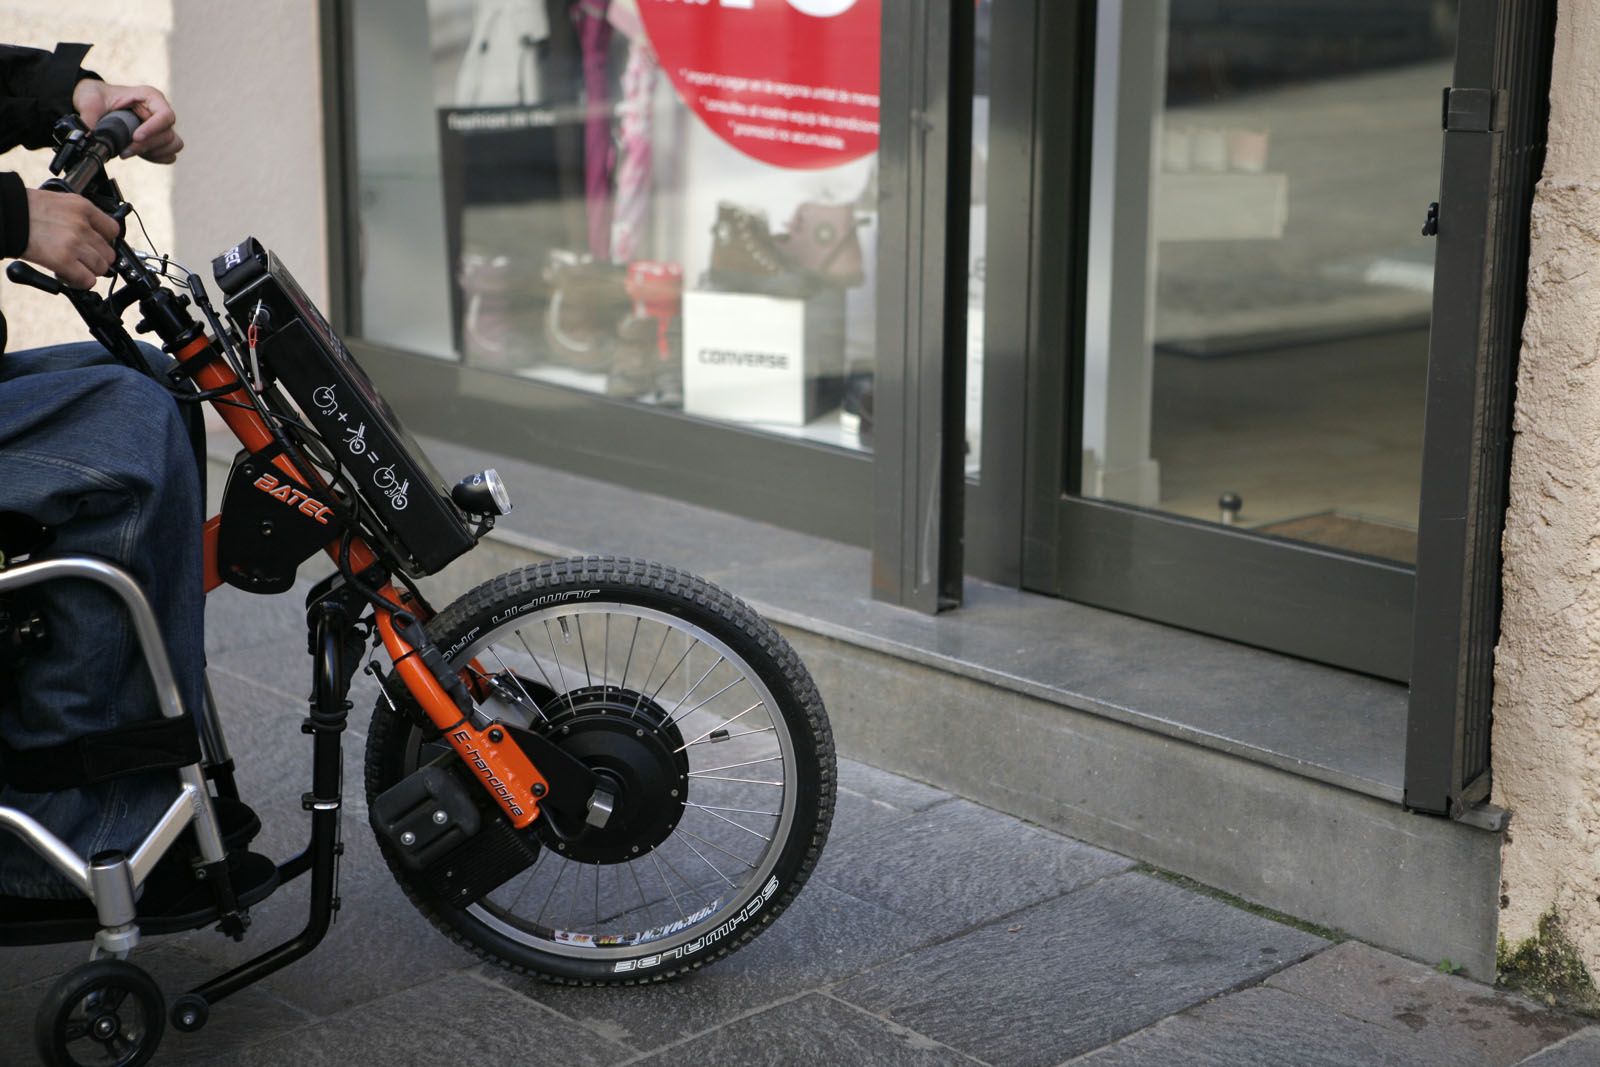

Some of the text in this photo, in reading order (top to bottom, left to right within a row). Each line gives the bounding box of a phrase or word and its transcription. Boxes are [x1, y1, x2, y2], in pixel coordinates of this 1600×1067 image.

[698, 347, 789, 370] CONVERSE
[253, 472, 336, 525] BATEC
[441, 625, 481, 664] JAC
[613, 874, 780, 974] SCHWALBE
